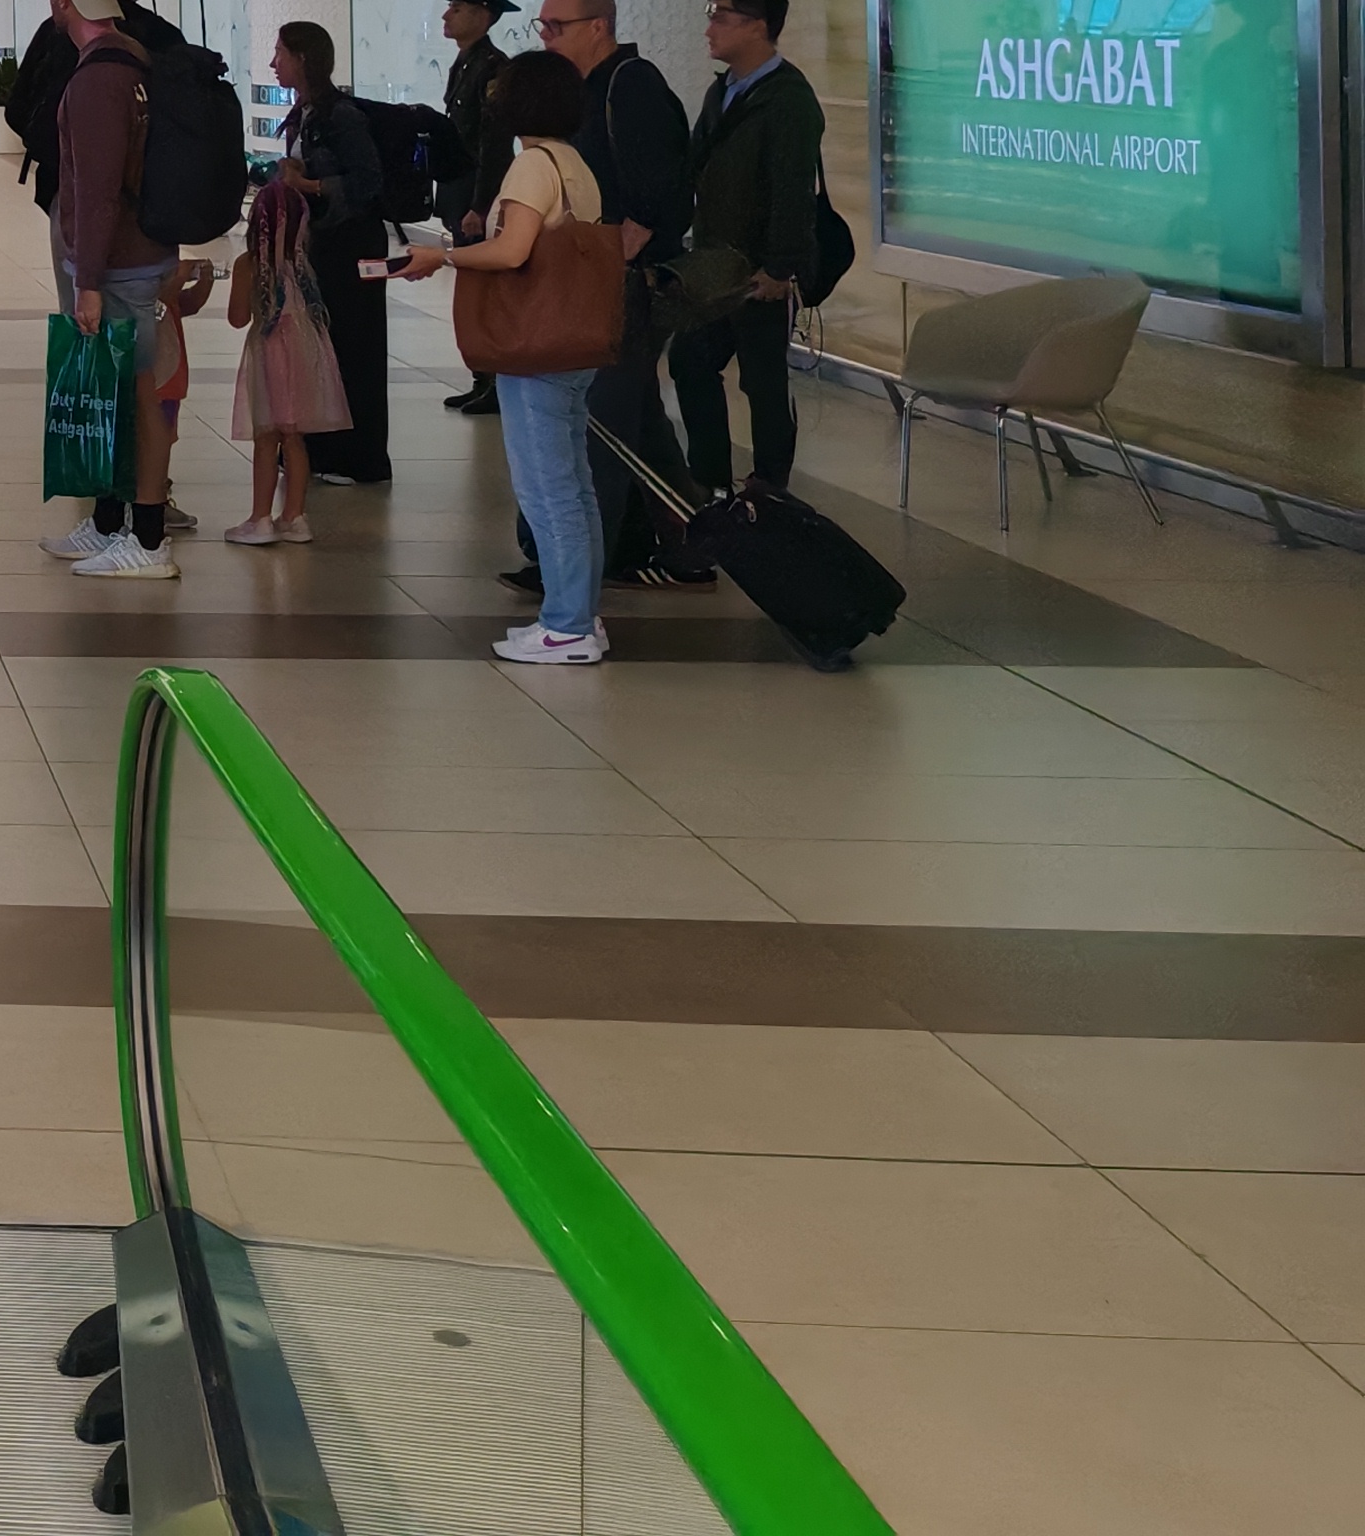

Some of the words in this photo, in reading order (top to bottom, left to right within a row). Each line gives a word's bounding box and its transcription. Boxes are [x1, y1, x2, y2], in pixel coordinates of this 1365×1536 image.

[975, 38, 1180, 108] ASHGABAT
[962, 122, 1104, 167] INTERNATIONAL
[1110, 135, 1201, 175] AIRPORT
